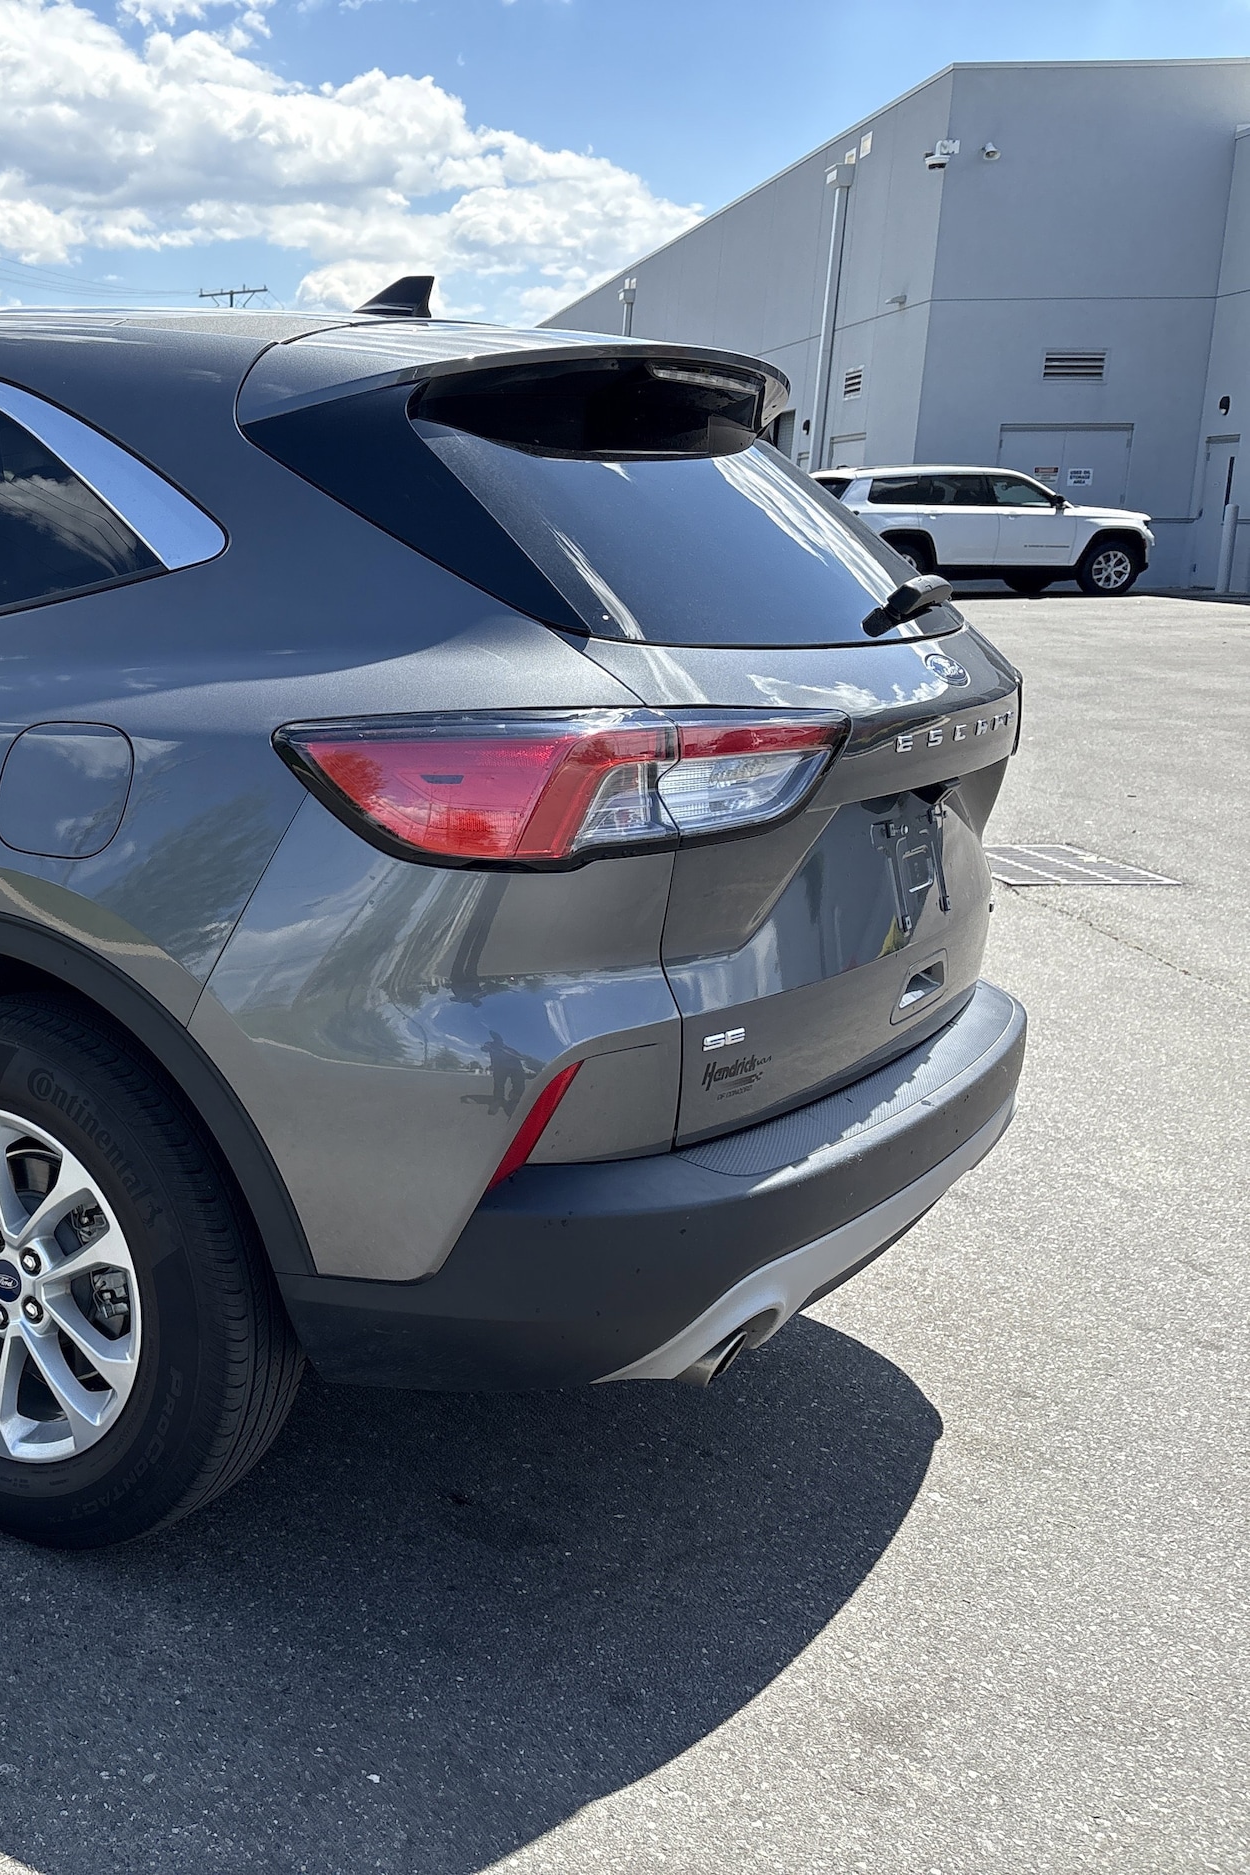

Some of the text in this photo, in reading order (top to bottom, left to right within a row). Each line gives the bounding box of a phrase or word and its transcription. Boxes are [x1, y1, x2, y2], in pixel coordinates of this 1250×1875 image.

[703, 1027, 746, 1052] SE
[702, 1055, 757, 1092] Hendrick
[27, 1067, 153, 1204] Continental
